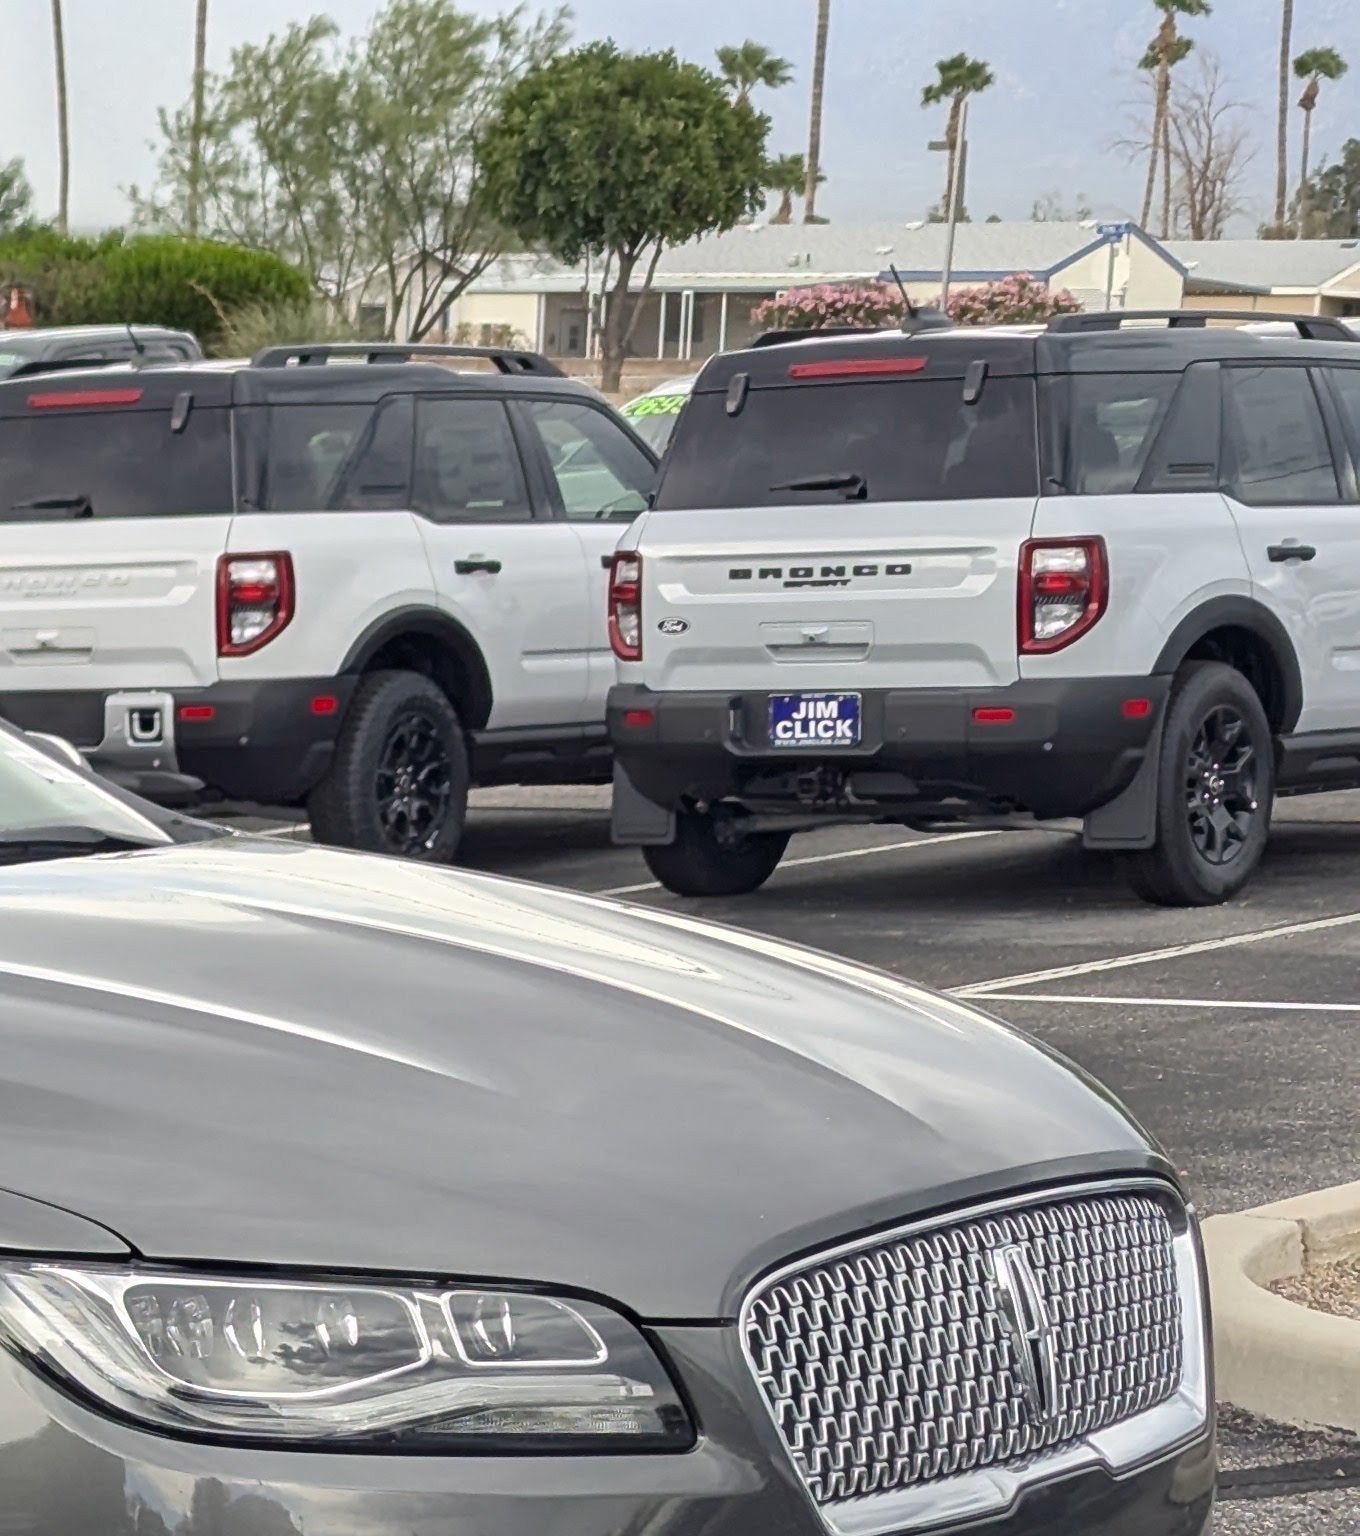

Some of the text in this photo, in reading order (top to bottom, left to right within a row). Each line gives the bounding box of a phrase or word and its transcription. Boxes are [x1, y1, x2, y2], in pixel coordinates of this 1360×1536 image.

[729, 563, 912, 580] BRONCO
[791, 700, 839, 719] JIM
[775, 719, 854, 739] CLICK
